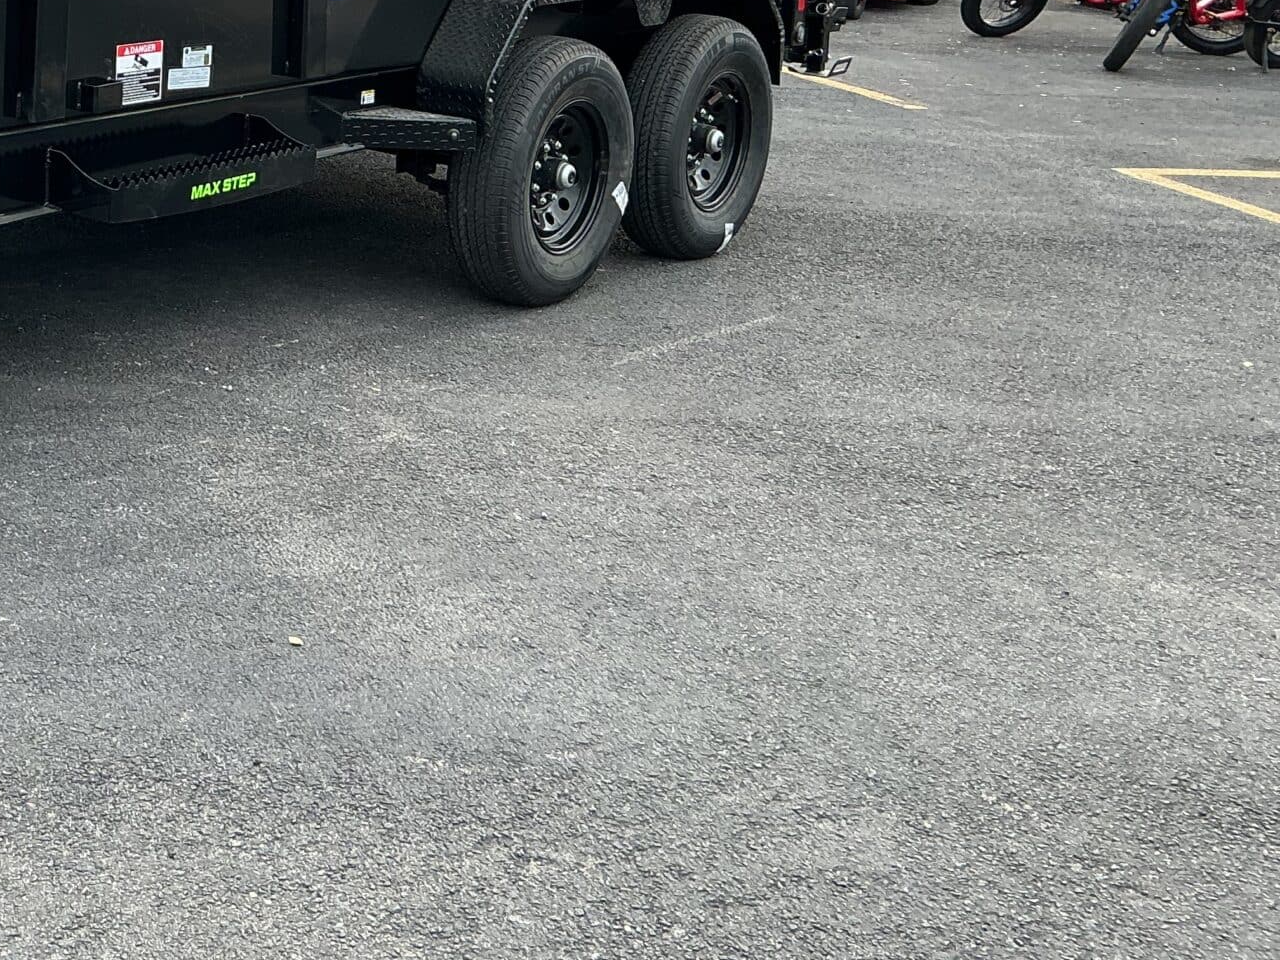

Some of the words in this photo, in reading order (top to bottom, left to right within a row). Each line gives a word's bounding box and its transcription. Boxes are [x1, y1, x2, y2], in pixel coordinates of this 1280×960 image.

[130, 43, 156, 54] DANGER
[191, 180, 221, 200] MAX
[222, 172, 256, 192] STEP
